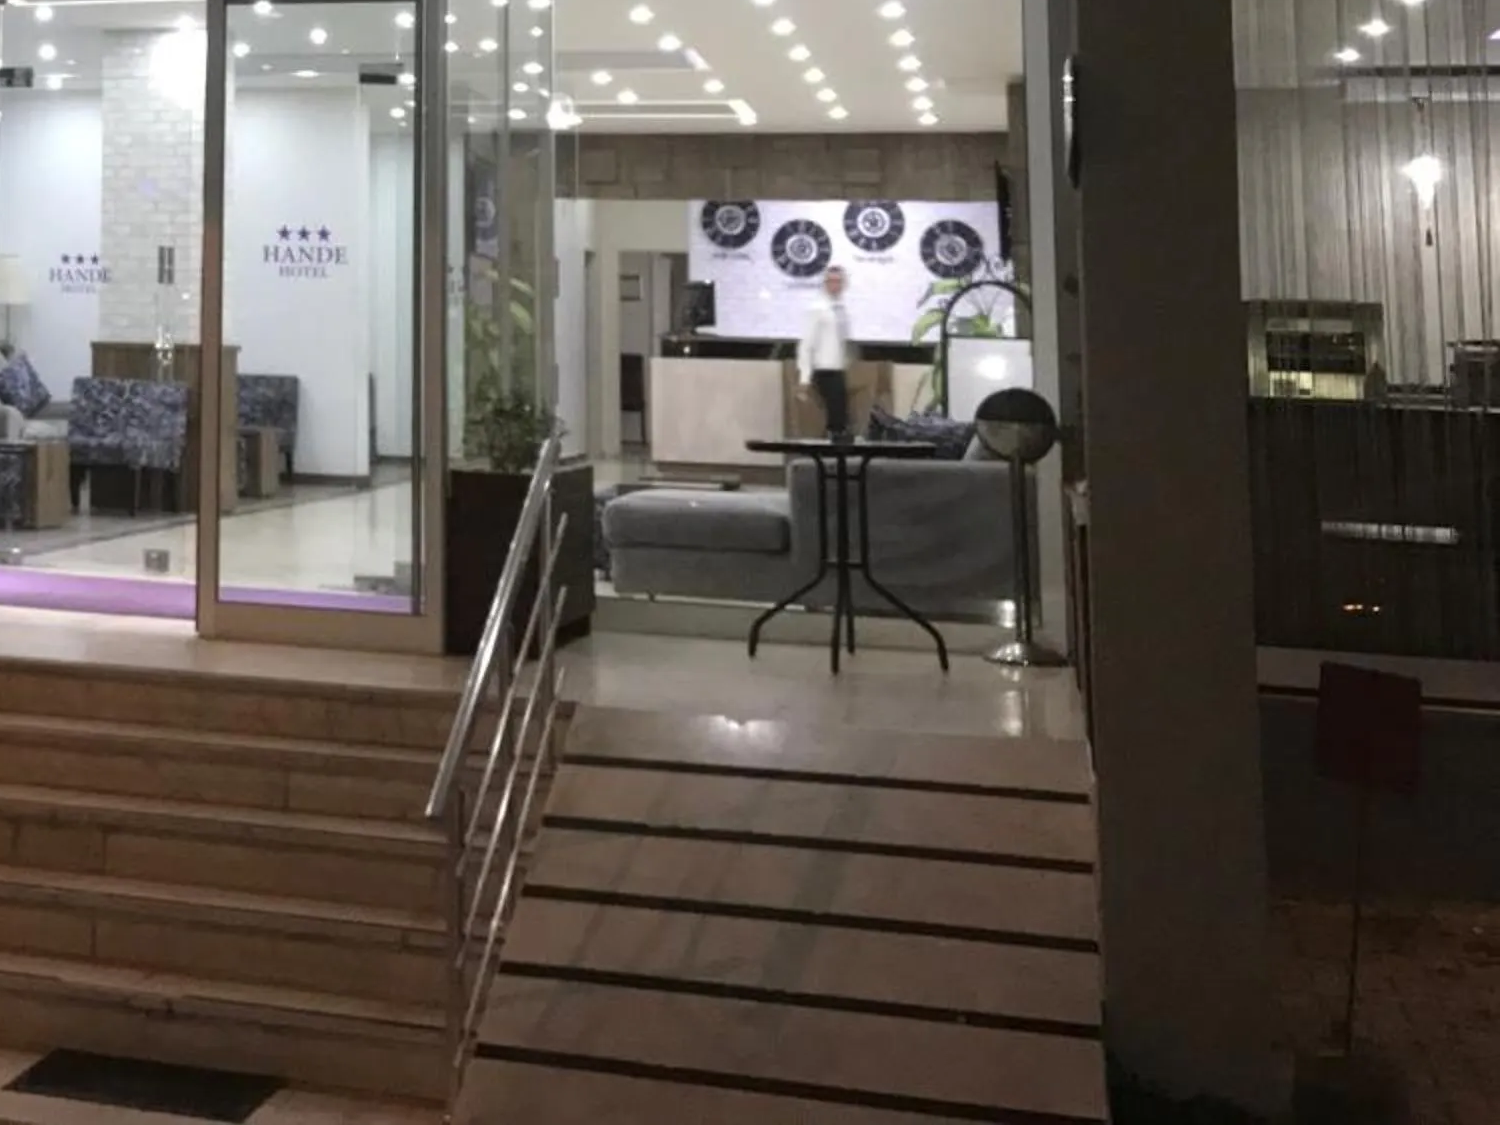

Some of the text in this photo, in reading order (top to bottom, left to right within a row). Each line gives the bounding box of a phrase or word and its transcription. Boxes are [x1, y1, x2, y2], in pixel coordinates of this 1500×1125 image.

[263, 245, 347, 264] HANDE
[49, 267, 112, 283] HANDE
[279, 265, 326, 277] HOTEL
